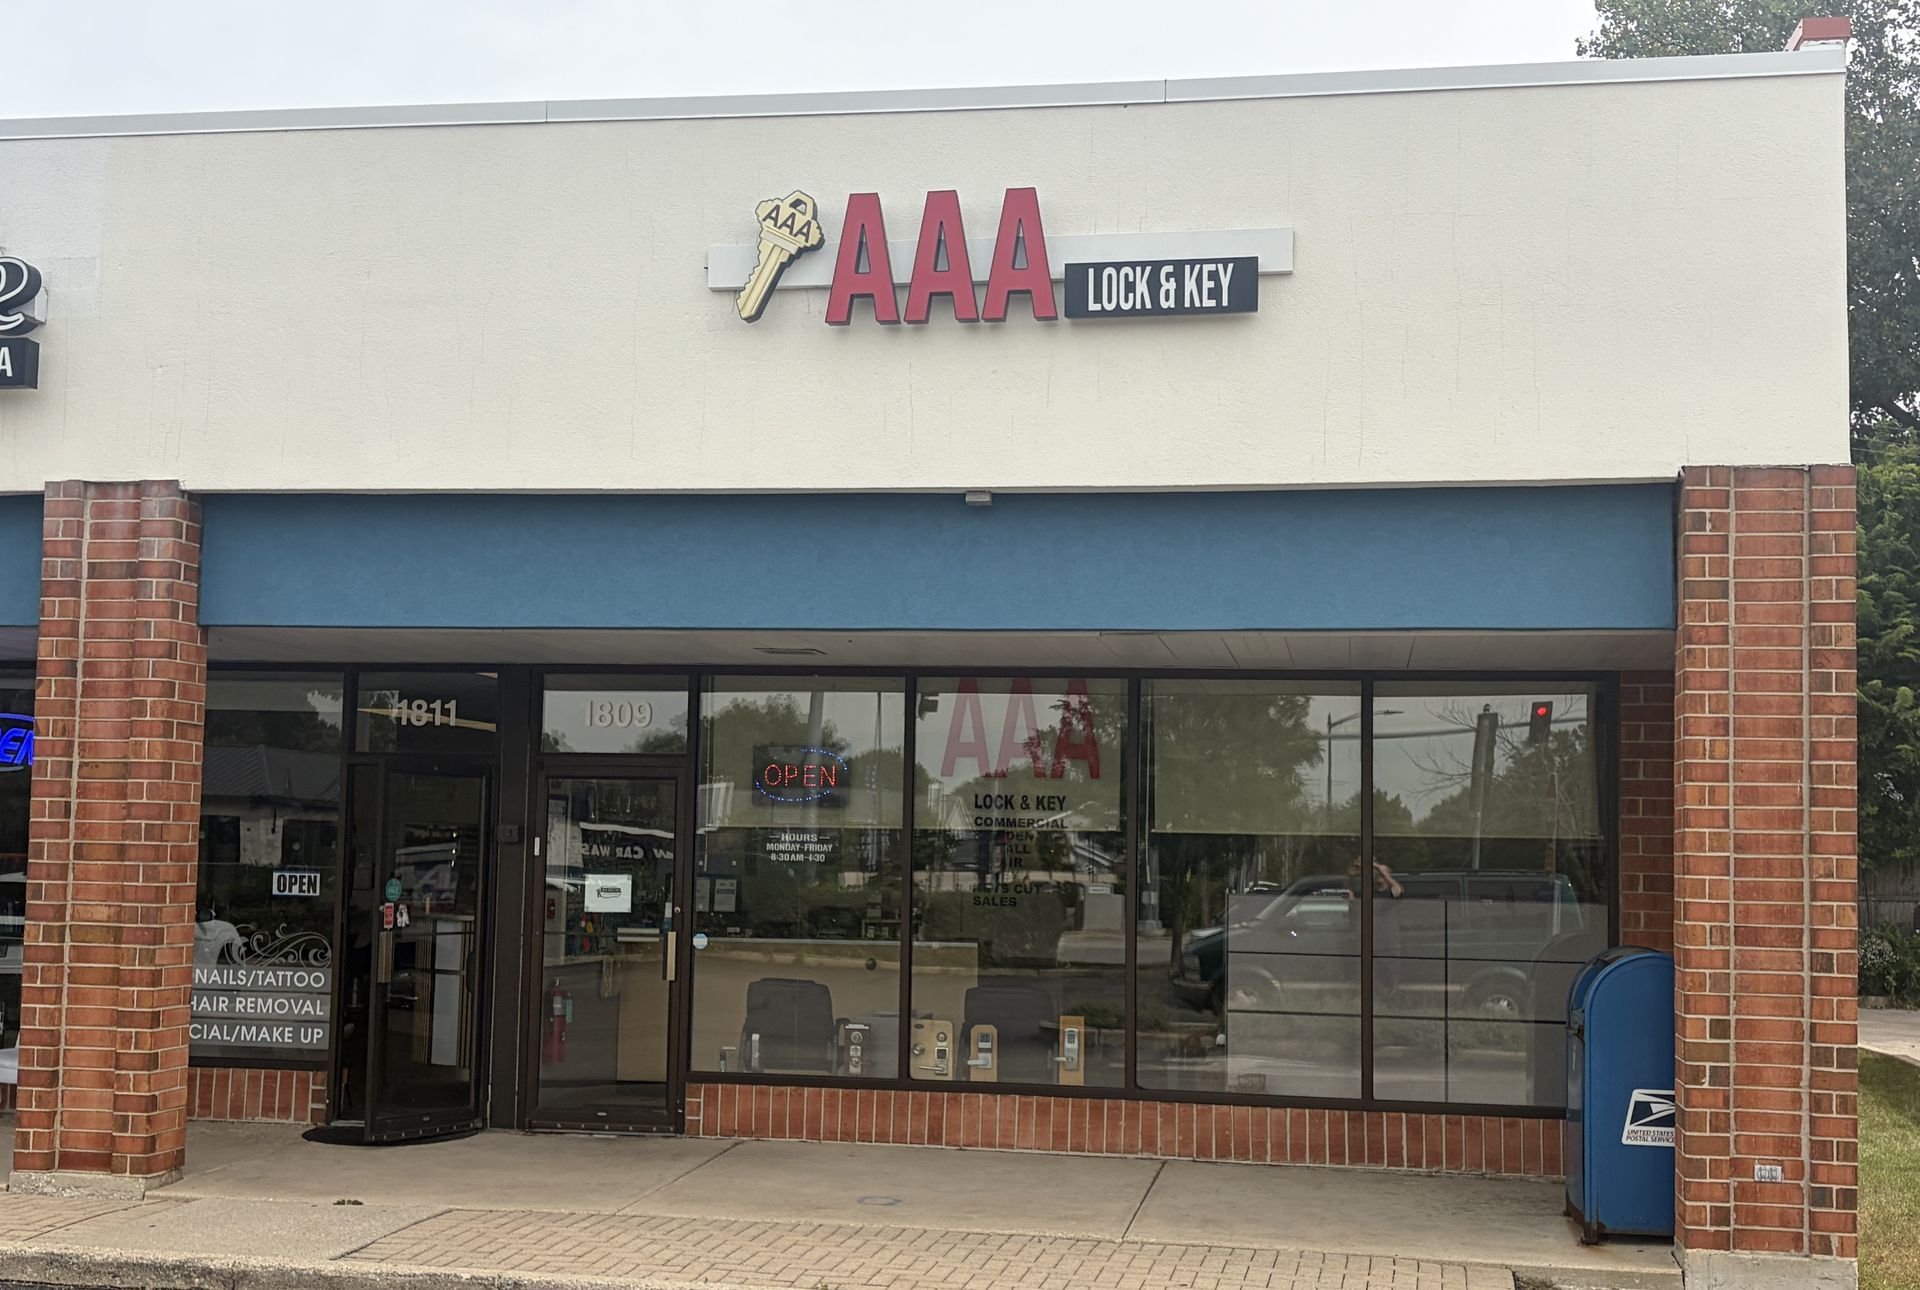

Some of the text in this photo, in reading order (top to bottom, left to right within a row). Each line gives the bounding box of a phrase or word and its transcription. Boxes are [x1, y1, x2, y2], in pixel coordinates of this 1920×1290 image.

[762, 204, 812, 243] AAA
[825, 187, 1058, 325] AAA
[1088, 262, 1234, 311] LOCK & KEY
[398, 699, 457, 727] 1811
[585, 700, 653, 728] 1809
[941, 677, 1100, 779] AAA
[765, 764, 837, 788] OPEN
[974, 794, 1067, 811] LOCK & KEY
[766, 843, 833, 852] MONDAY-FRIDAY
[781, 833, 818, 842] HOURS
[276, 874, 318, 894] OPEN
[973, 896, 1017, 907] SALES
[194, 968, 326, 988] NAILS/TATTOO
[235, 997, 325, 1016] REMOVAL
[300, 1028, 324, 1044] UP
